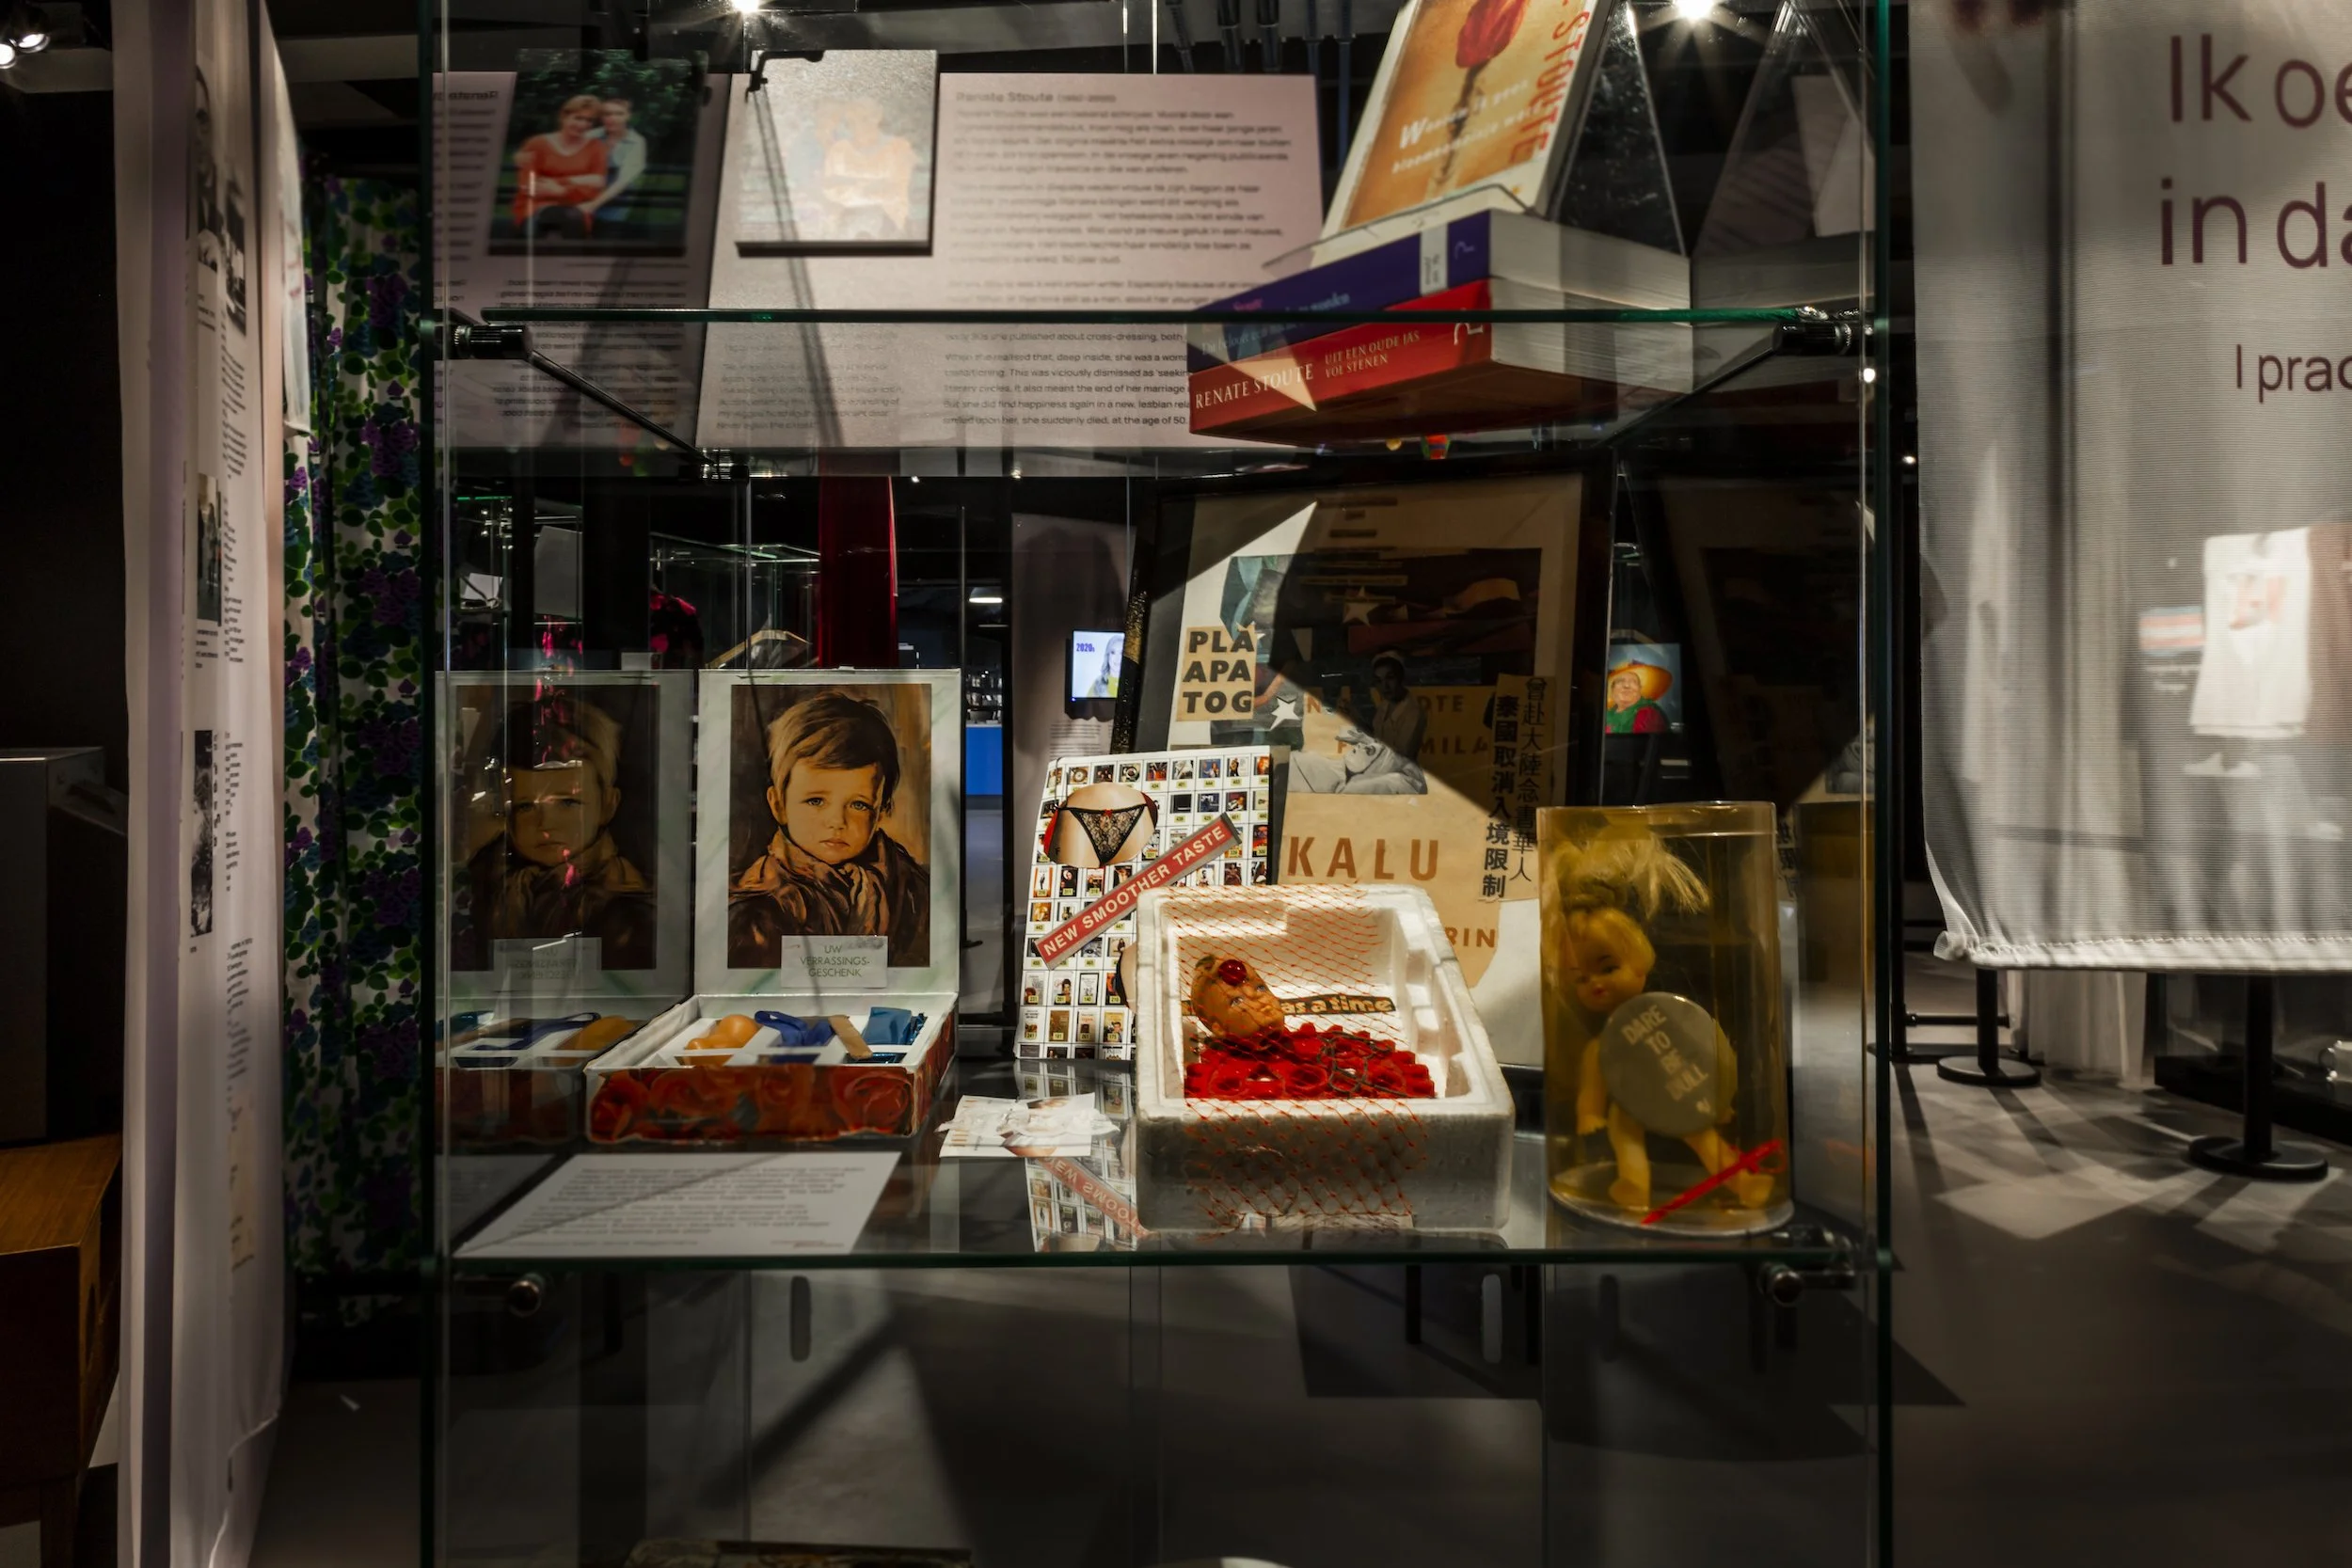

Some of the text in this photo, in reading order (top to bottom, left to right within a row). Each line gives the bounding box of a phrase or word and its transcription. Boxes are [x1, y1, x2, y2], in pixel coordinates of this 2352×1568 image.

[2169, 33, 2253, 123] Ik
[2161, 176, 2248, 266] in
[1057, 354, 1081, 362] deep
[1115, 354, 1132, 362] she
[1134, 354, 1152, 362] was
[1324, 330, 1421, 366] UIT EEN OUDE JAS
[1093, 369, 1141, 377] dismissed
[1142, 369, 1154, 377] as
[1325, 352, 1389, 379] VOL STENEN
[2235, 343, 2243, 388] I
[1044, 385, 1074, 393] meant
[1076, 385, 1092, 393] the
[1094, 385, 1112, 393] end
[1114, 385, 1124, 393] of
[1125, 385, 1141, 393] her
[1143, 385, 1185, 393] marriage
[1195, 363, 1314, 409] RENATE STOUTE
[1018, 401, 1067, 409] happiness
[1069, 401, 1095, 409] again
[1096, 401, 1105, 409] in
[1138, 401, 1172, 409] lesbian
[1022, 416, 1040, 425] she
[1041, 416, 1085, 425] suddenly
[1111, 416, 1122, 425] at
[1123, 416, 1140, 425] the
[1141, 416, 1160, 425] age
[1161, 416, 1172, 425] of
[1188, 630, 1255, 653] PLA
[1182, 659, 1251, 682] APA
[1183, 690, 1253, 713] TOG
[1286, 836, 1439, 881] KALU
[1042, 826, 1226, 957] NEW SMOOTHER TASTE
[823, 944, 843, 954] UW
[800, 956, 870, 966] VERRASSINGS-
[808, 968, 863, 978] GESCHENK
[1311, 1000, 1327, 1013] a
[1328, 995, 1393, 1012] time
[1620, 1005, 1668, 1045] DARE
[1644, 1030, 1672, 1055] TO
